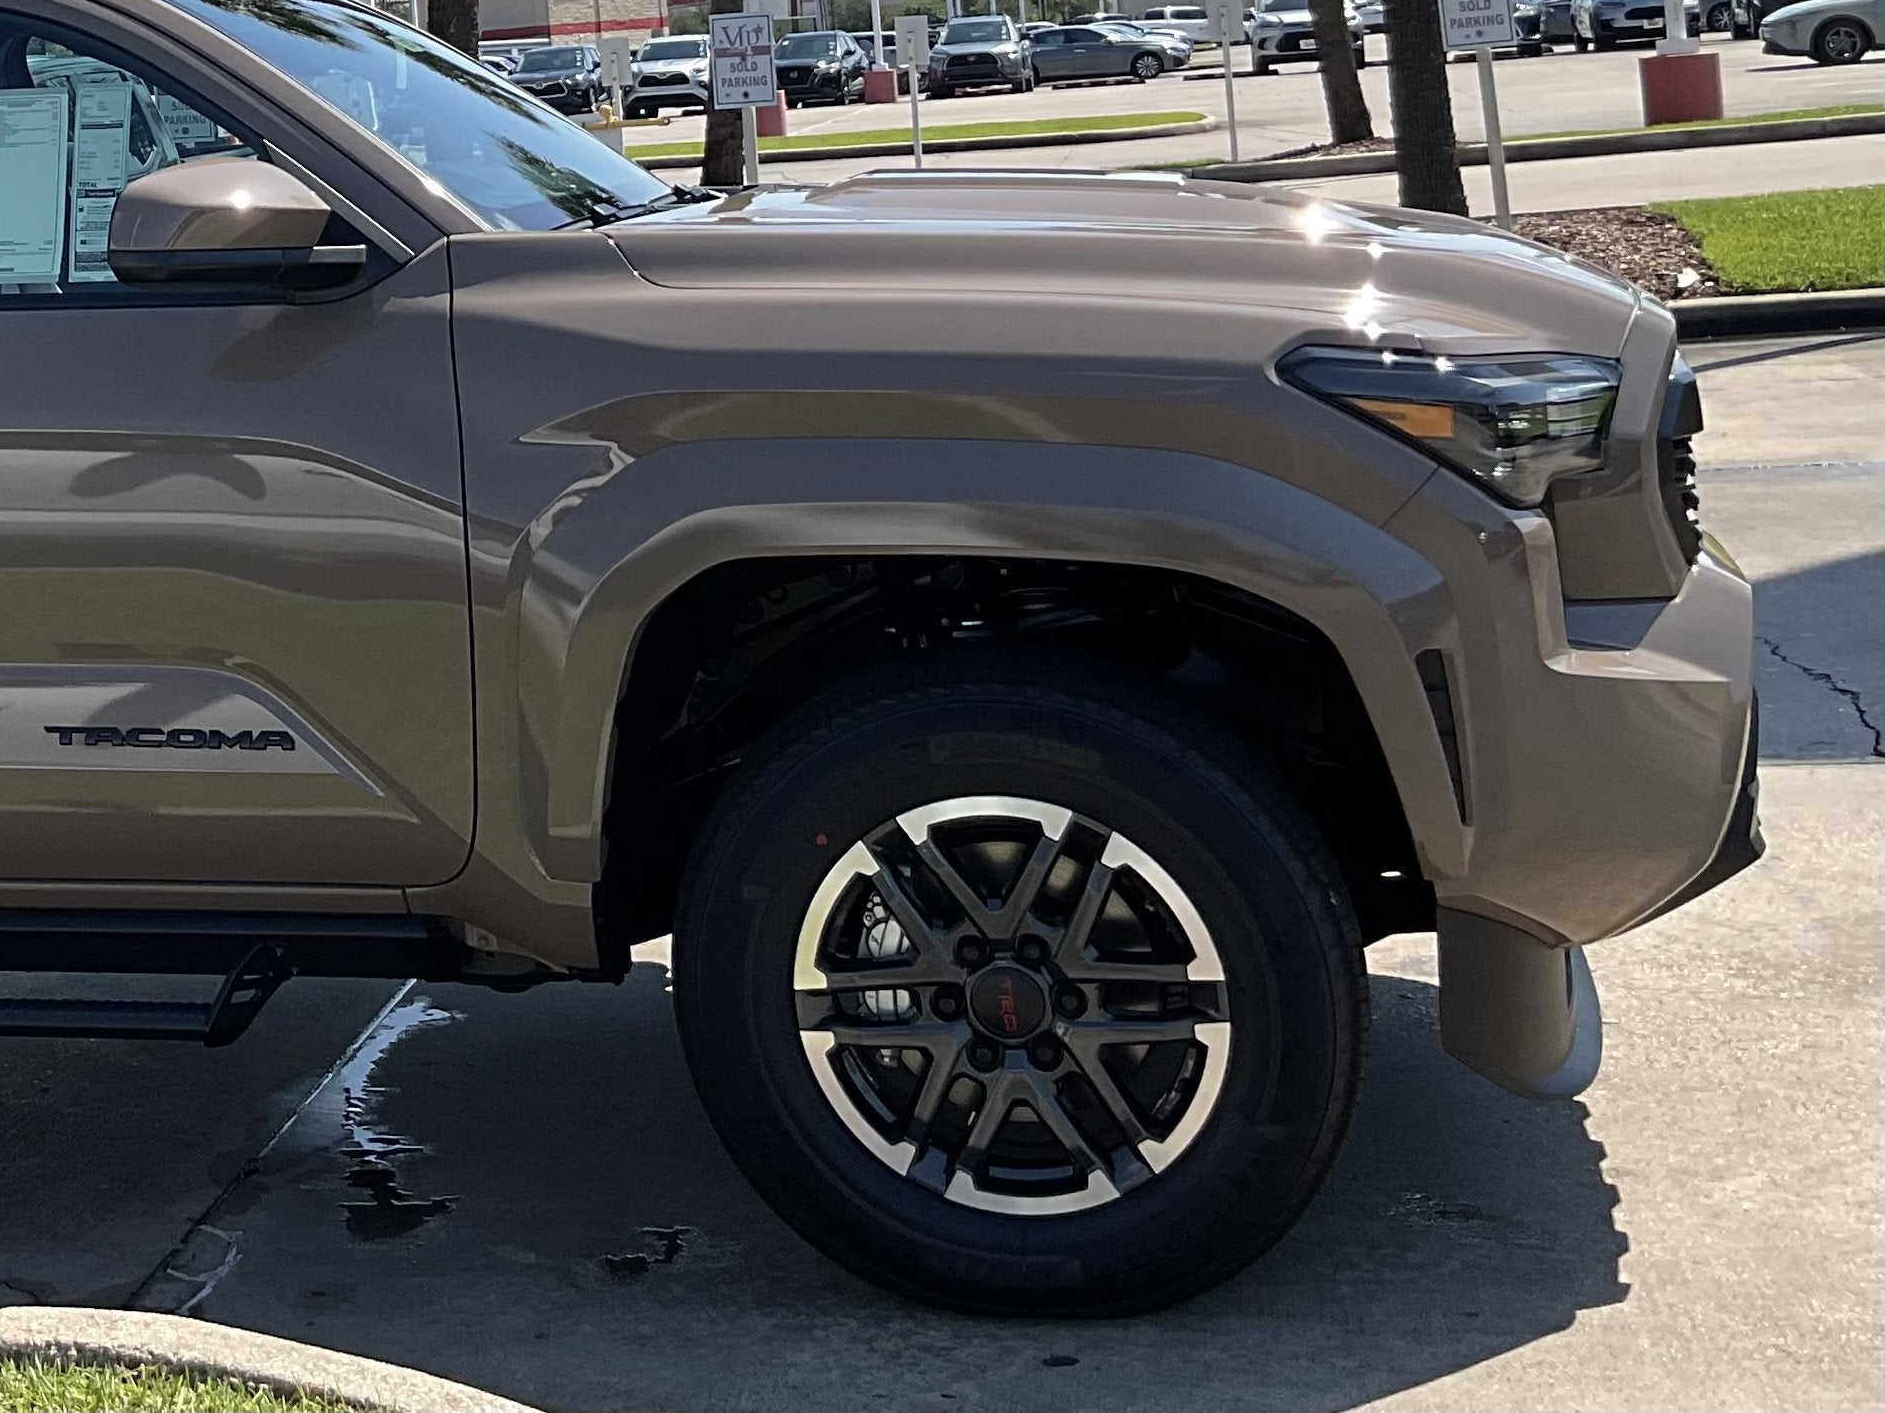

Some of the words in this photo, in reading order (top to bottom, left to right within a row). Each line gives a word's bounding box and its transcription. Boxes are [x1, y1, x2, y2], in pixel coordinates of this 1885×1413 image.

[1458, 0, 1491, 12] SOLD
[1450, 14, 1504, 29] PARKING
[730, 61, 758, 73] SOLD
[721, 75, 768, 88] PARKING
[164, 114, 206, 125] PARKING
[44, 726, 296, 750] TACOMA
